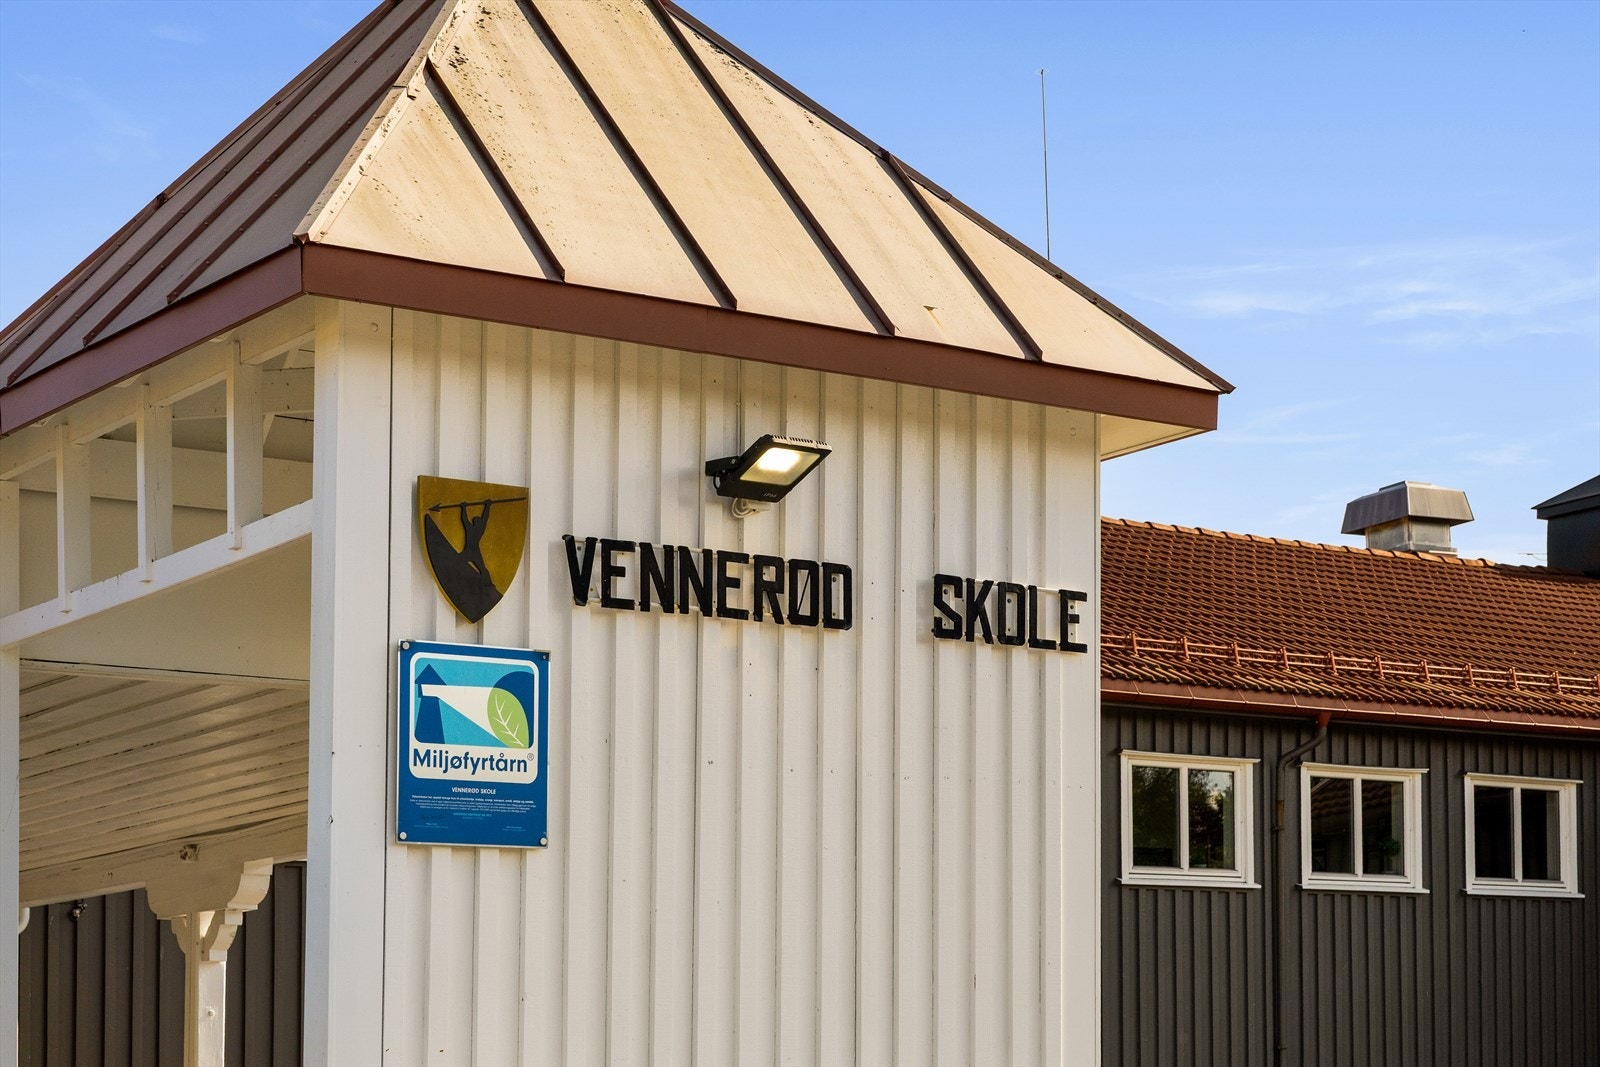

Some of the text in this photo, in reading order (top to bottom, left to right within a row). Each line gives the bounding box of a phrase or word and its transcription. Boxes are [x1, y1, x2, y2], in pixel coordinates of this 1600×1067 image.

[562, 534, 1088, 654] VENNERØD SKOLE
[413, 748, 528, 775] Miljøfyrtårn
[451, 786, 497, 795] VENNERØD SKOLE
